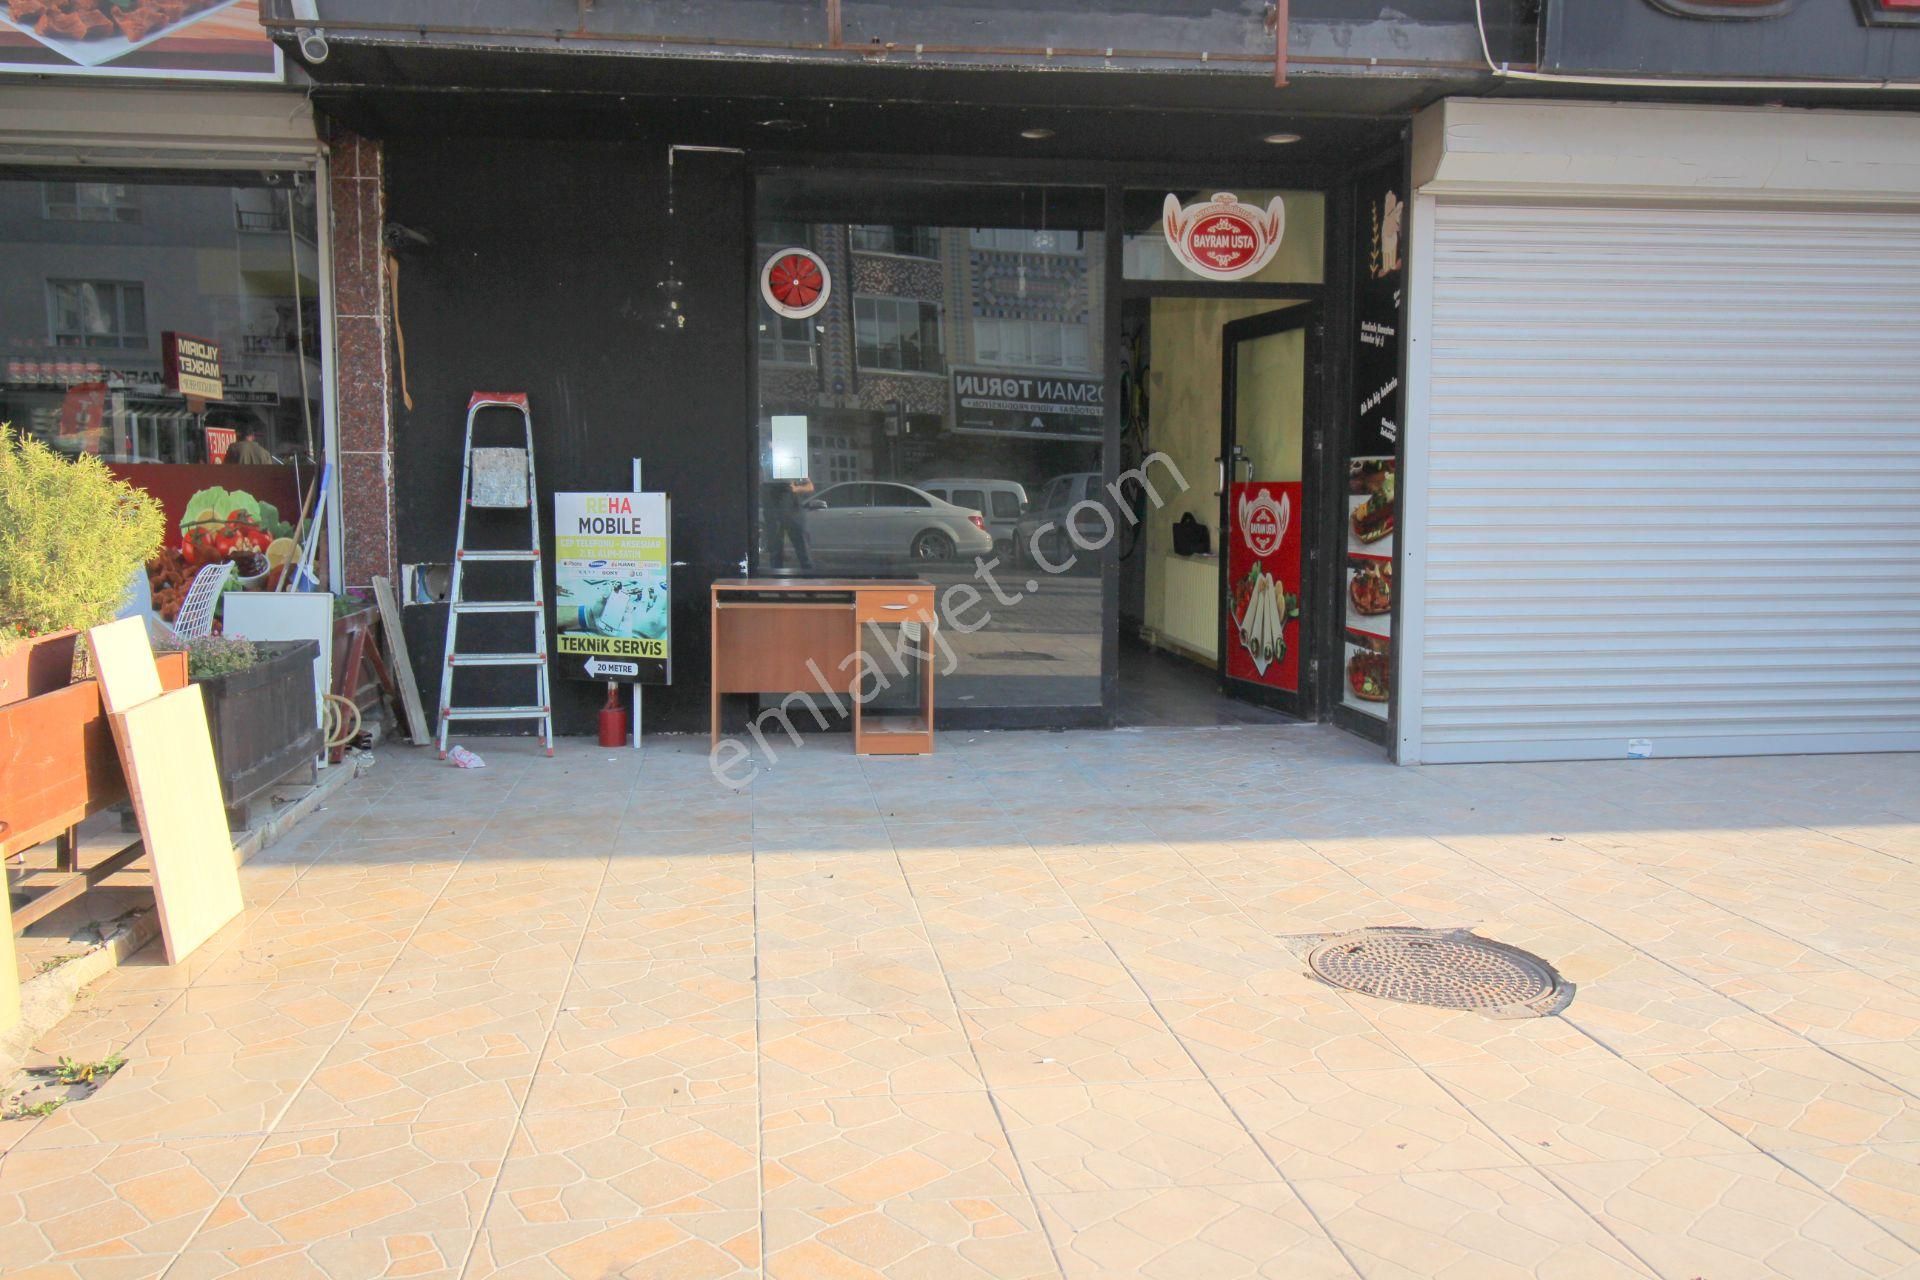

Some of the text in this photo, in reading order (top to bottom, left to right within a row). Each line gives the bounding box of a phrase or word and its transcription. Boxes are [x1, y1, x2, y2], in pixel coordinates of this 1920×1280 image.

[1193, 234, 1254, 249] BAYRAM USTA
[586, 497, 632, 514] REHA
[578, 517, 642, 535] MOBILE
[597, 663, 633, 673] 20 METRE
